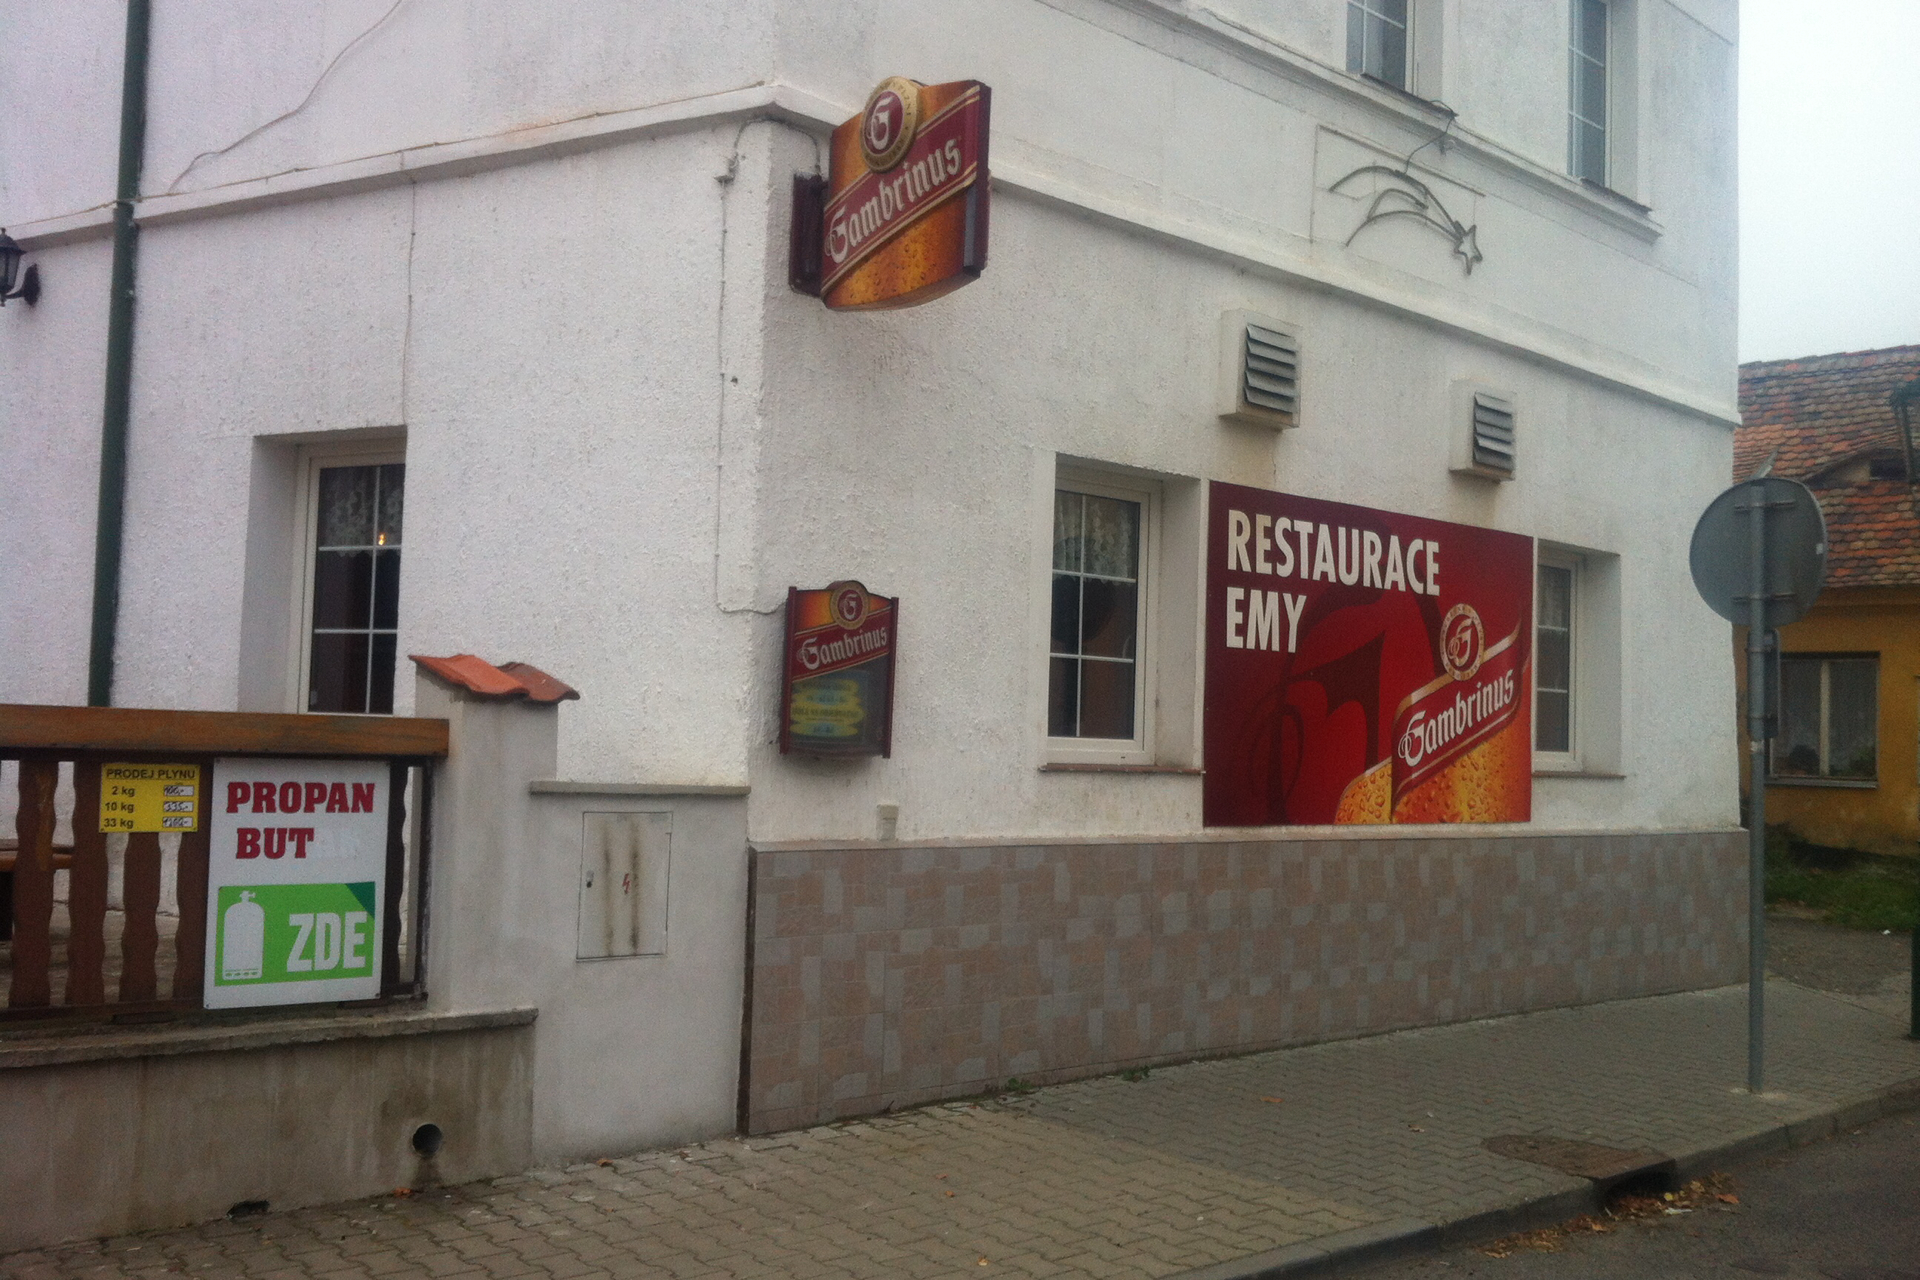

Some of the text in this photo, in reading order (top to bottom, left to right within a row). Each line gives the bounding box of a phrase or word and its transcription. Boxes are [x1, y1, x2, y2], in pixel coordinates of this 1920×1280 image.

[824, 138, 962, 263] Gambrinus
[1227, 509, 1440, 596] RESTAURACE
[1226, 586, 1307, 653] EMY
[797, 626, 888, 670] Gambrinus
[1398, 669, 1514, 767] Gambrinus
[106, 768, 195, 779] PRODEJ PLYNU
[112, 786, 136, 797] 2 kg
[105, 802, 134, 813] 10 kg
[226, 781, 376, 813] PROPAN
[104, 817, 134, 829] 33 kg
[236, 828, 314, 859] BUT
[286, 911, 368, 973] ZDE
